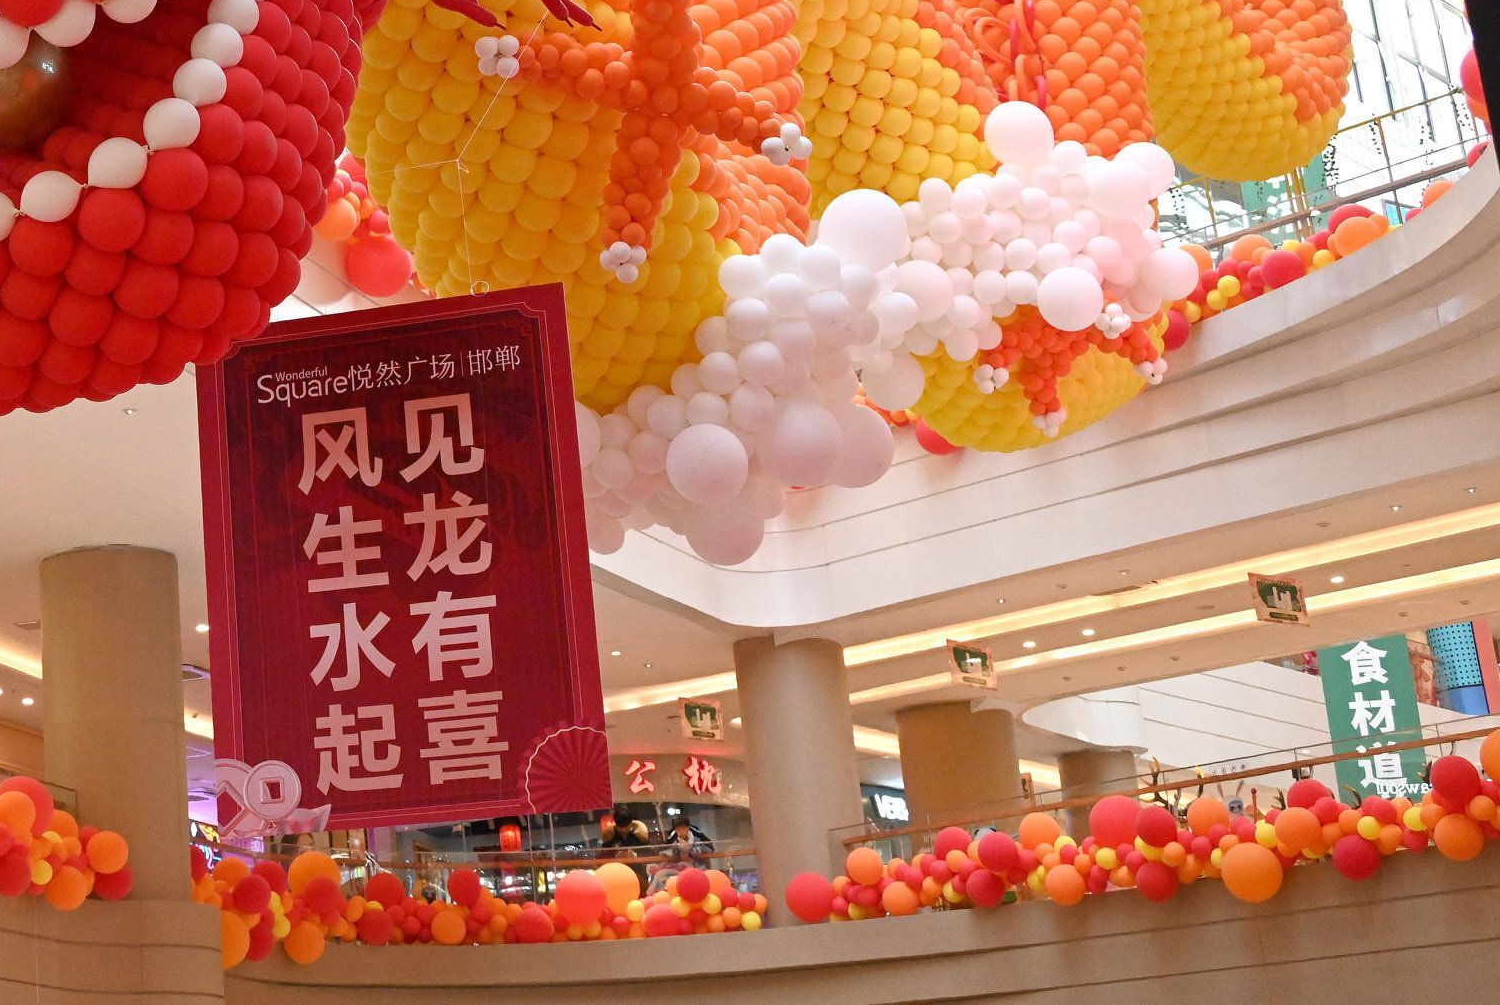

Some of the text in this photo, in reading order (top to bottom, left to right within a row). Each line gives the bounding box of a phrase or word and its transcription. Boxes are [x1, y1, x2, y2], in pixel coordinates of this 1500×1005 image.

[257, 345, 520, 407] Square 悦然广场 邯郸
[275, 365, 328, 383] Wonderful
[298, 407, 404, 795] 风生水起
[399, 392, 510, 785] 见龙有喜
[1341, 641, 1407, 800] 食材道
